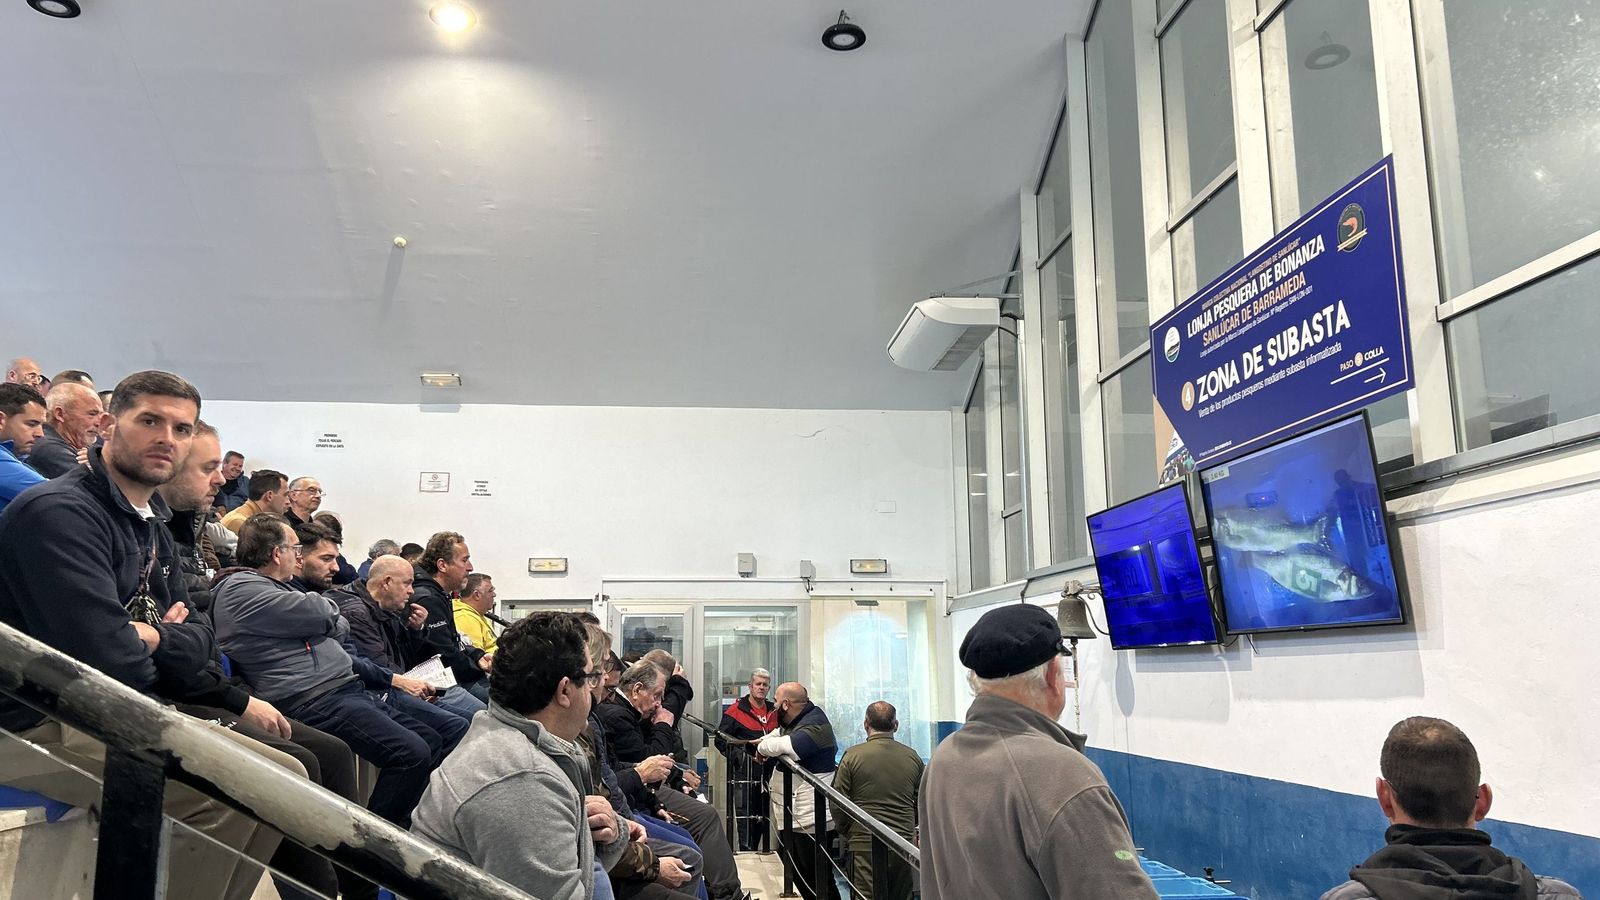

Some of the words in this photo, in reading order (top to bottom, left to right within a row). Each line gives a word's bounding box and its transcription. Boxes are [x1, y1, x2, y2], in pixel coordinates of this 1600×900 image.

[1187, 309, 1214, 338] LONJA
[1213, 279, 1259, 322] PESQUERA
[1260, 267, 1273, 291] DE
[1274, 234, 1325, 282] BONANZA
[1203, 312, 1240, 347] SANLÚCAR
[1241, 304, 1252, 323] DE
[1253, 271, 1306, 316] BARRAMEDA
[1196, 359, 1240, 404] ZONA
[1242, 344, 1264, 380] DE
[1267, 299, 1351, 366] SUBASTA
[1198, 405, 1210, 418] Venta
[1210, 403, 1215, 414] de
[1221, 390, 1242, 409] productos
[1241, 380, 1264, 400] pesqueros
[1264, 370, 1286, 387] mediante
[1286, 360, 1305, 378] subasta
[1305, 341, 1342, 366] informatizada
[1340, 359, 1354, 372] PASO
[1364, 346, 1384, 361] COLLA
